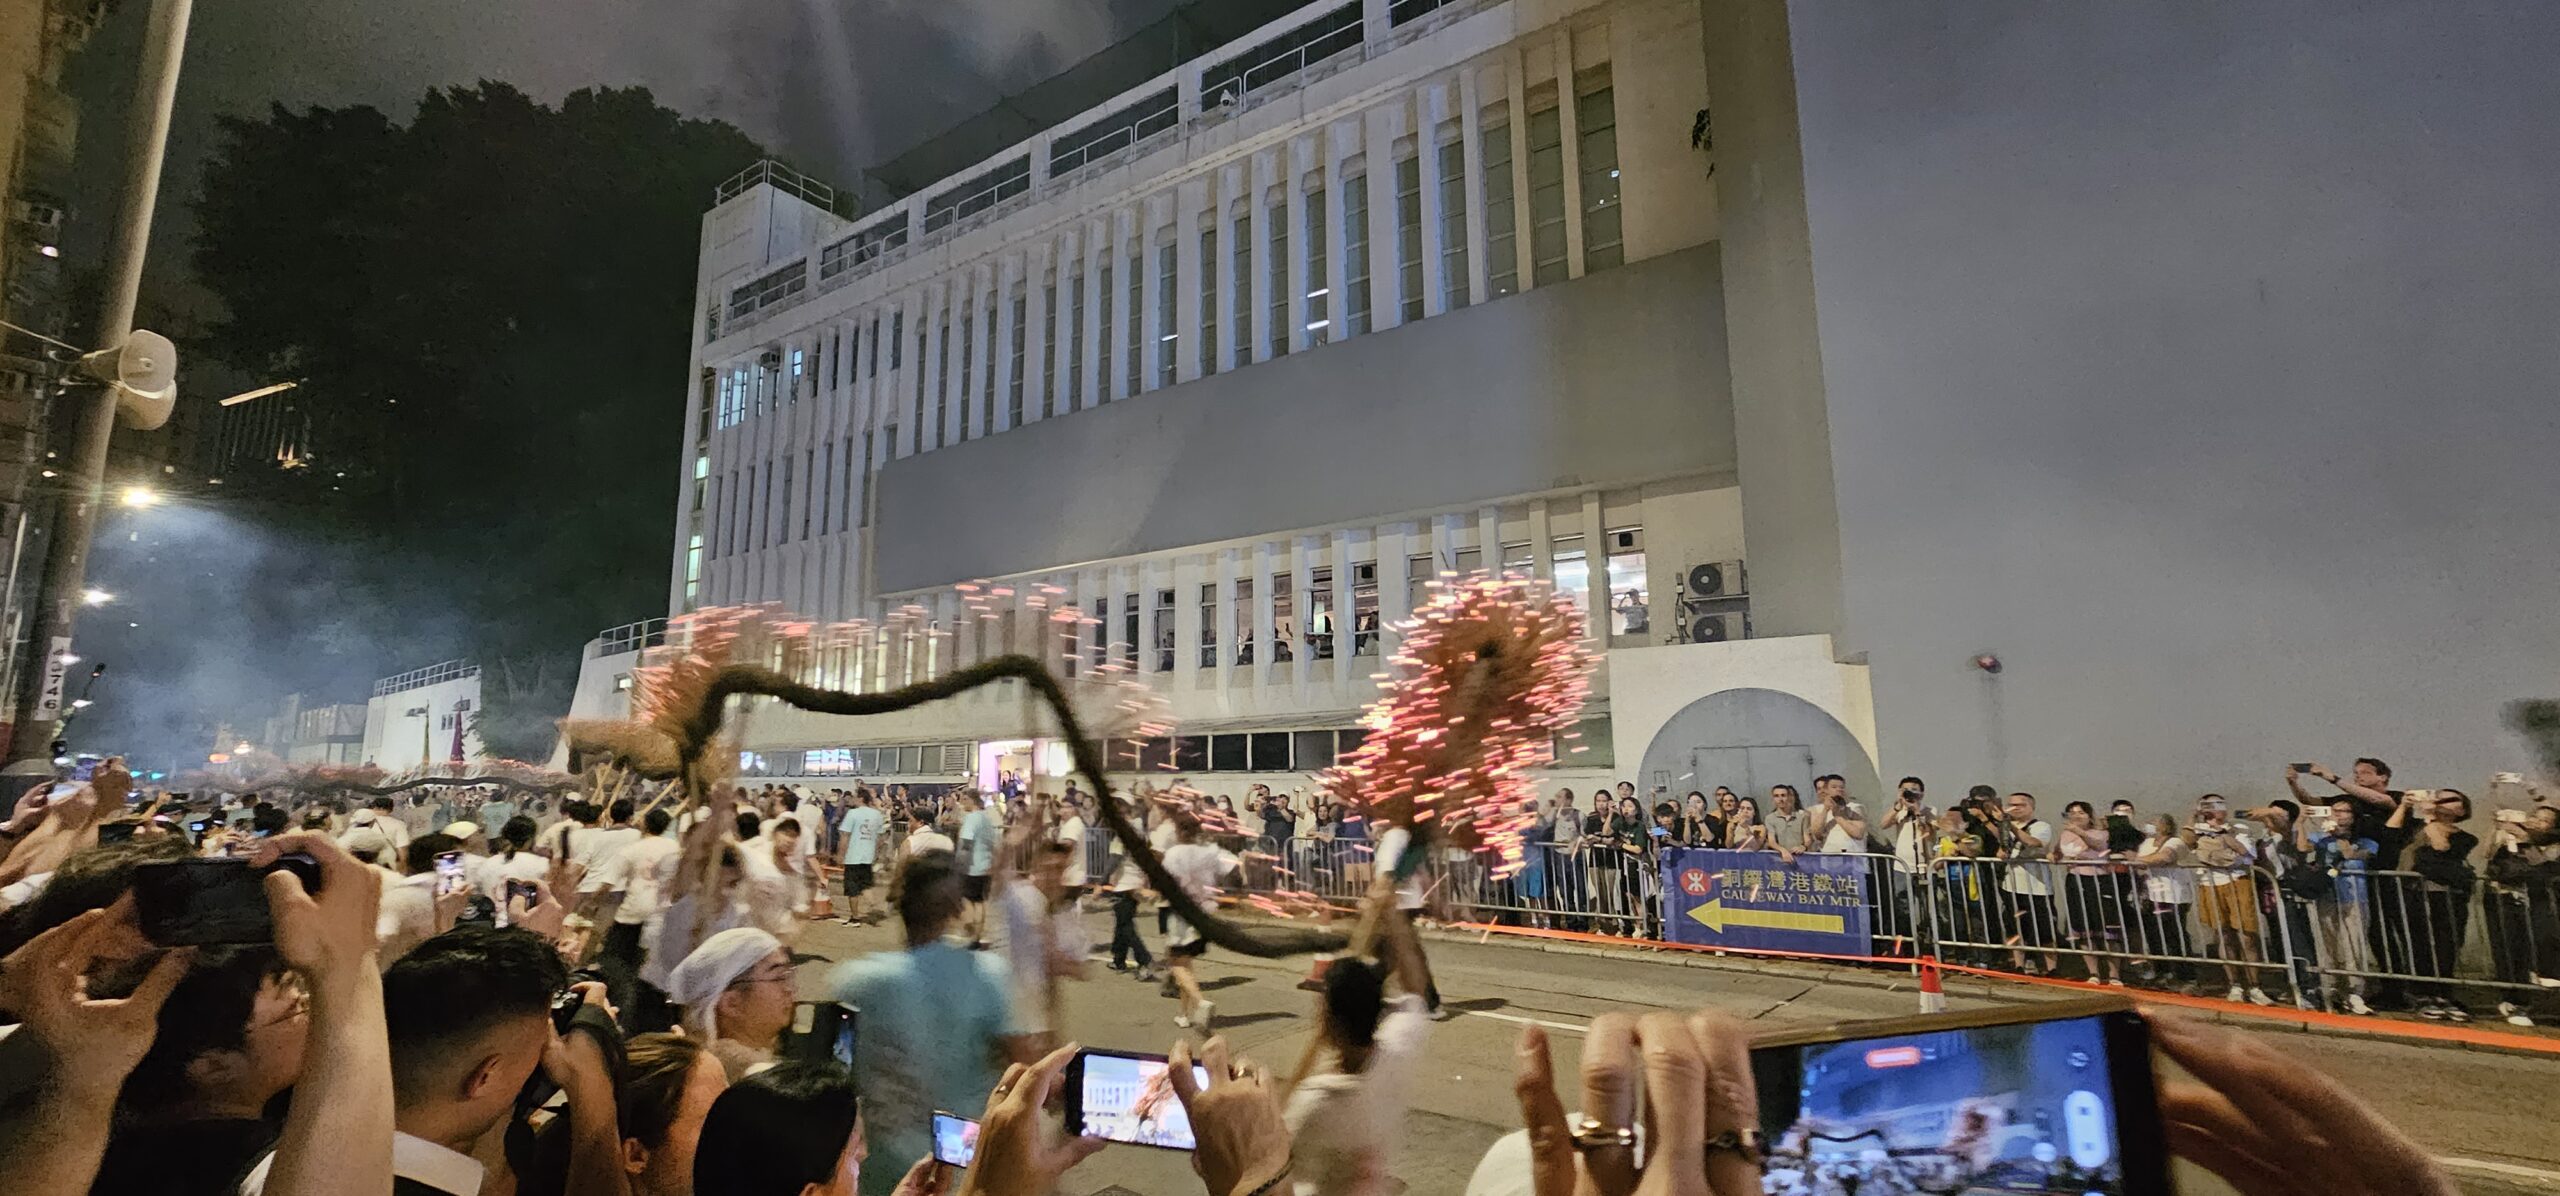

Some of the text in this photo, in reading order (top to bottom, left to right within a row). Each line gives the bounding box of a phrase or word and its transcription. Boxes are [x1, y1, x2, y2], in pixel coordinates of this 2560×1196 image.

[1721, 868, 1859, 896] 銅鑼灣港鐵站
[1721, 889, 1861, 907] CAUEWAY BAY MTR
